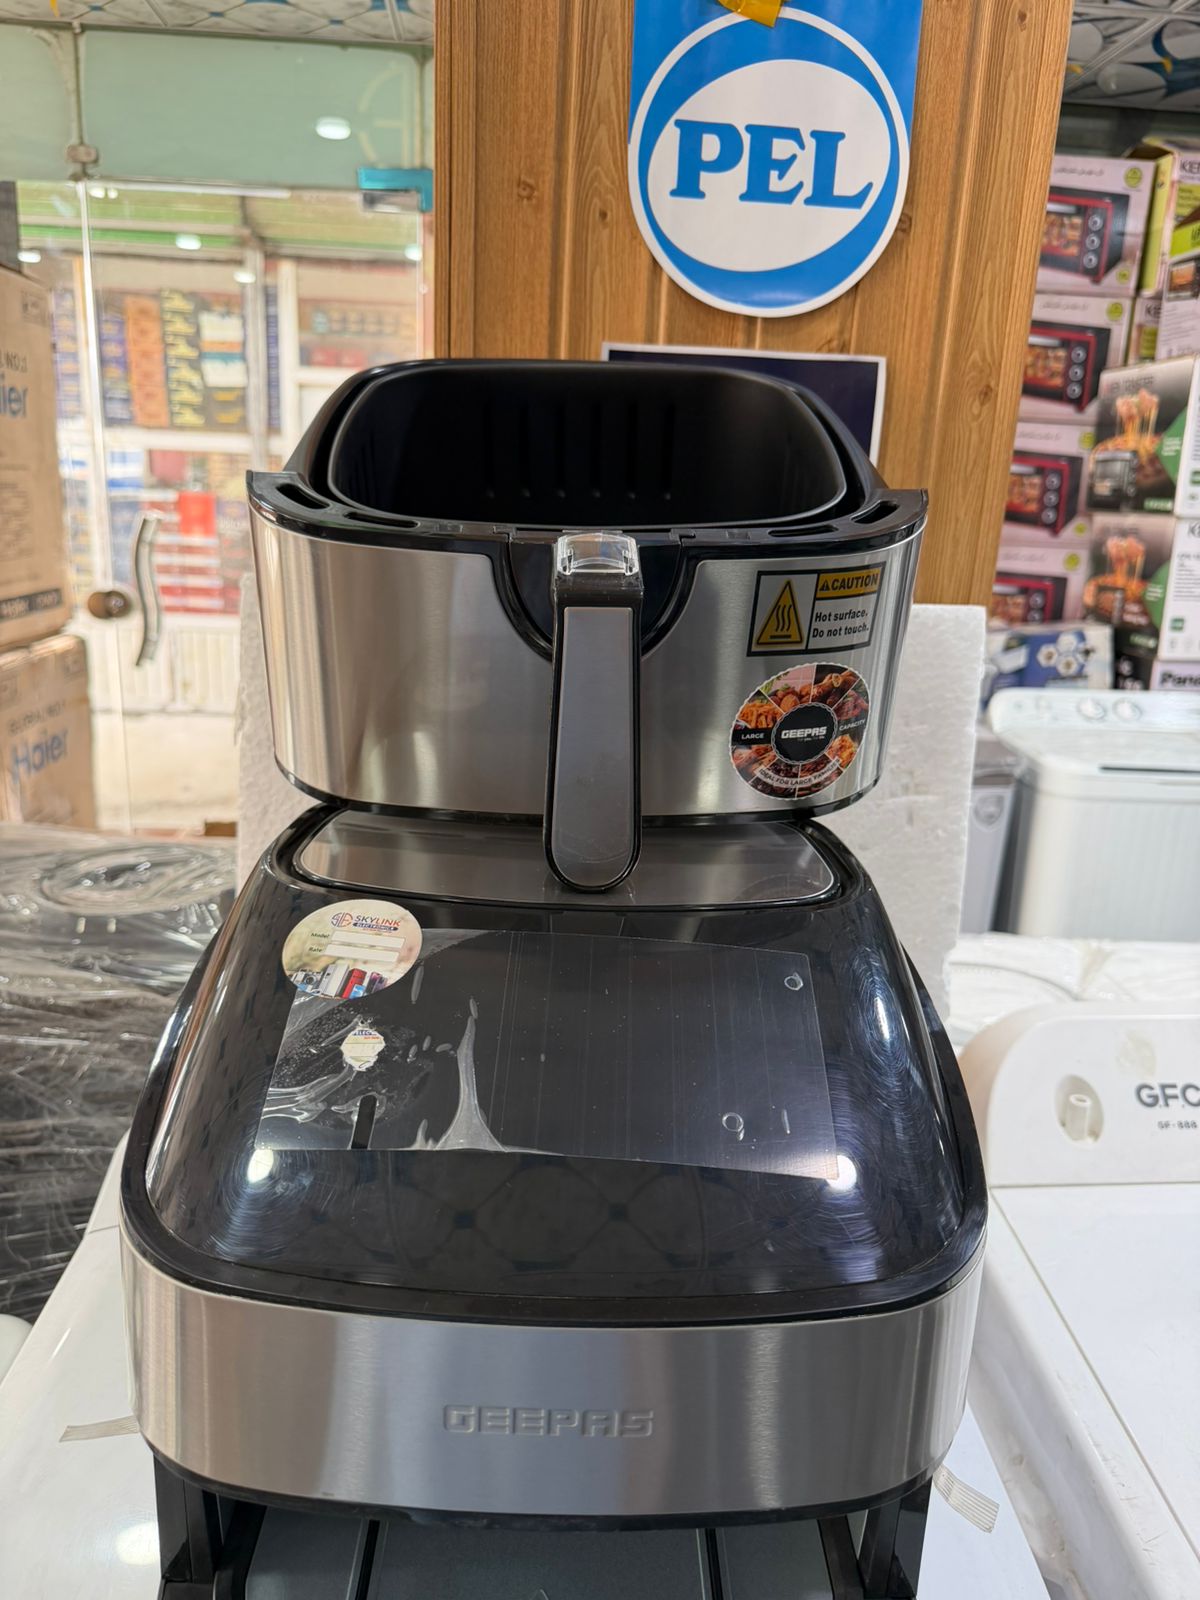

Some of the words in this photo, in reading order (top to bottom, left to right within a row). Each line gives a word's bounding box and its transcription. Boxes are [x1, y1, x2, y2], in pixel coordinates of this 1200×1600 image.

[669, 118, 874, 210] PEL
[831, 573, 880, 591] CAUTION
[815, 612, 832, 623] Hot
[834, 609, 868, 622] surface.
[812, 628, 824, 638] Do
[827, 626, 842, 637] not
[844, 623, 869, 635] touch.
[839, 719, 866, 731] CAPACITY
[742, 732, 765, 740] LARGE
[781, 726, 828, 739] GEEPAS
[776, 776, 789, 785] FOR
[789, 777, 812, 786] LARGE
[355, 914, 401, 927] SKYLINK
[443, 1404, 654, 1438] GEEPAS
